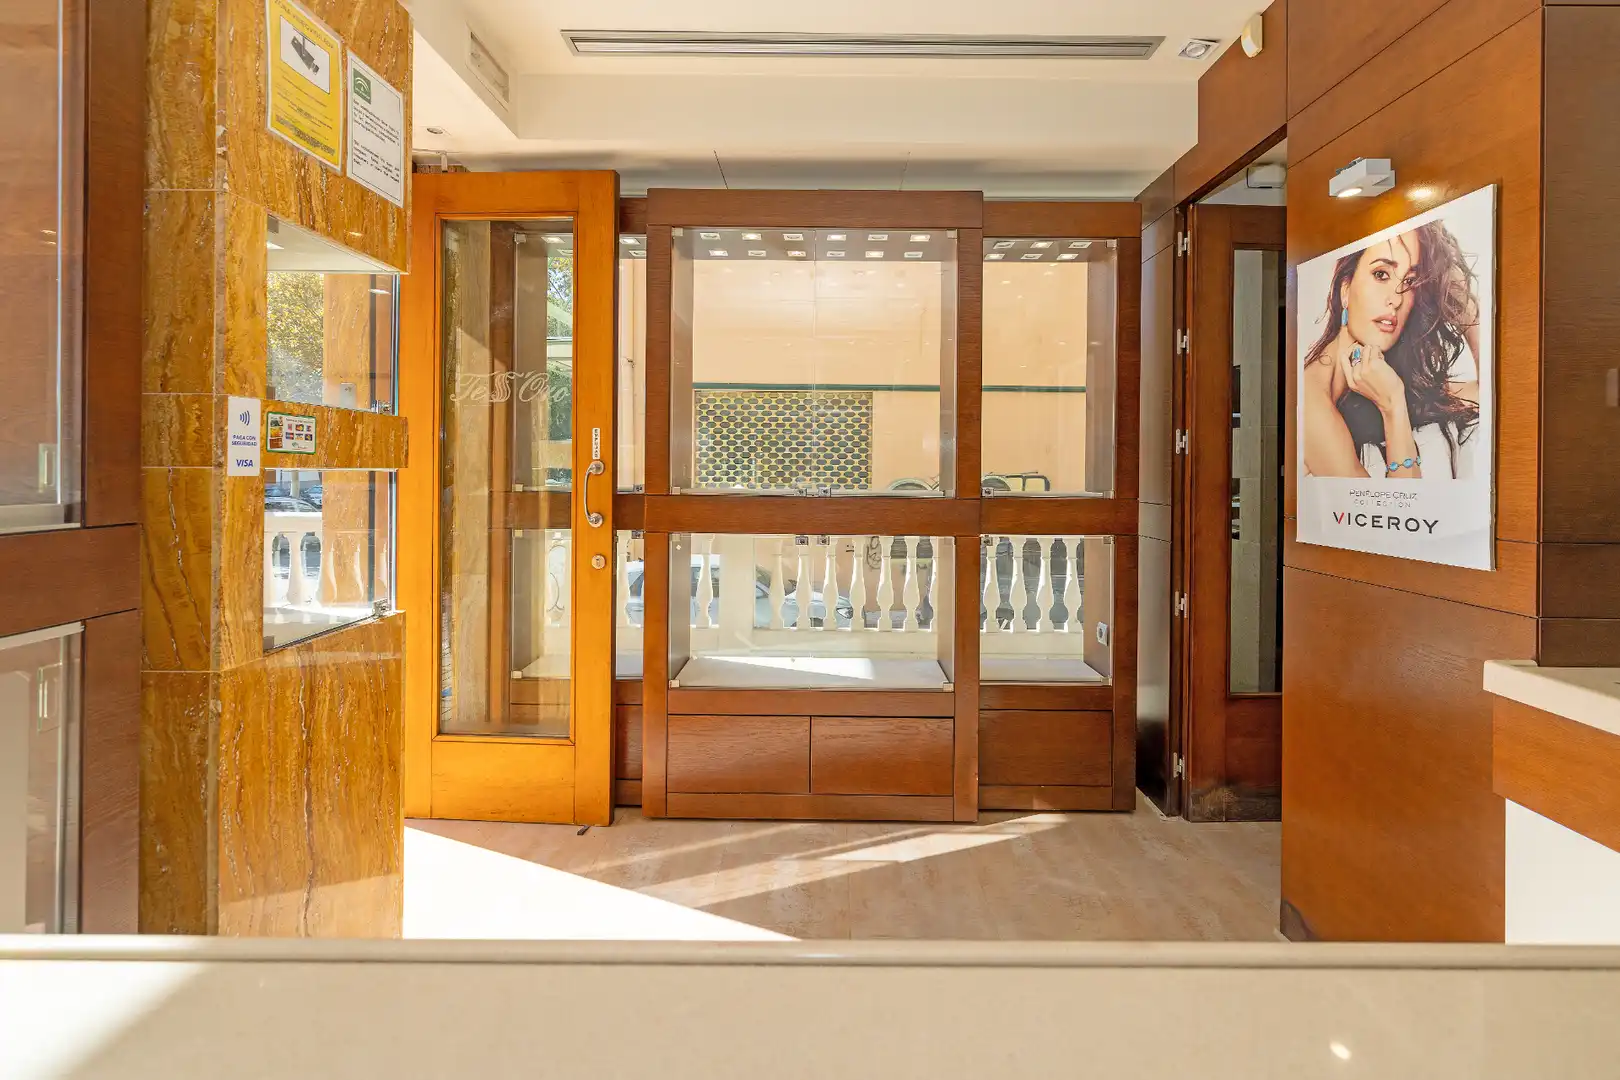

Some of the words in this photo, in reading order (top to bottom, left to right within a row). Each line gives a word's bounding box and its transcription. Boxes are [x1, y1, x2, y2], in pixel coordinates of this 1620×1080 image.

[236, 459, 253, 467] VISA
[1392, 491, 1418, 501] CRUZ
[1333, 511, 1439, 534] VICEROY
